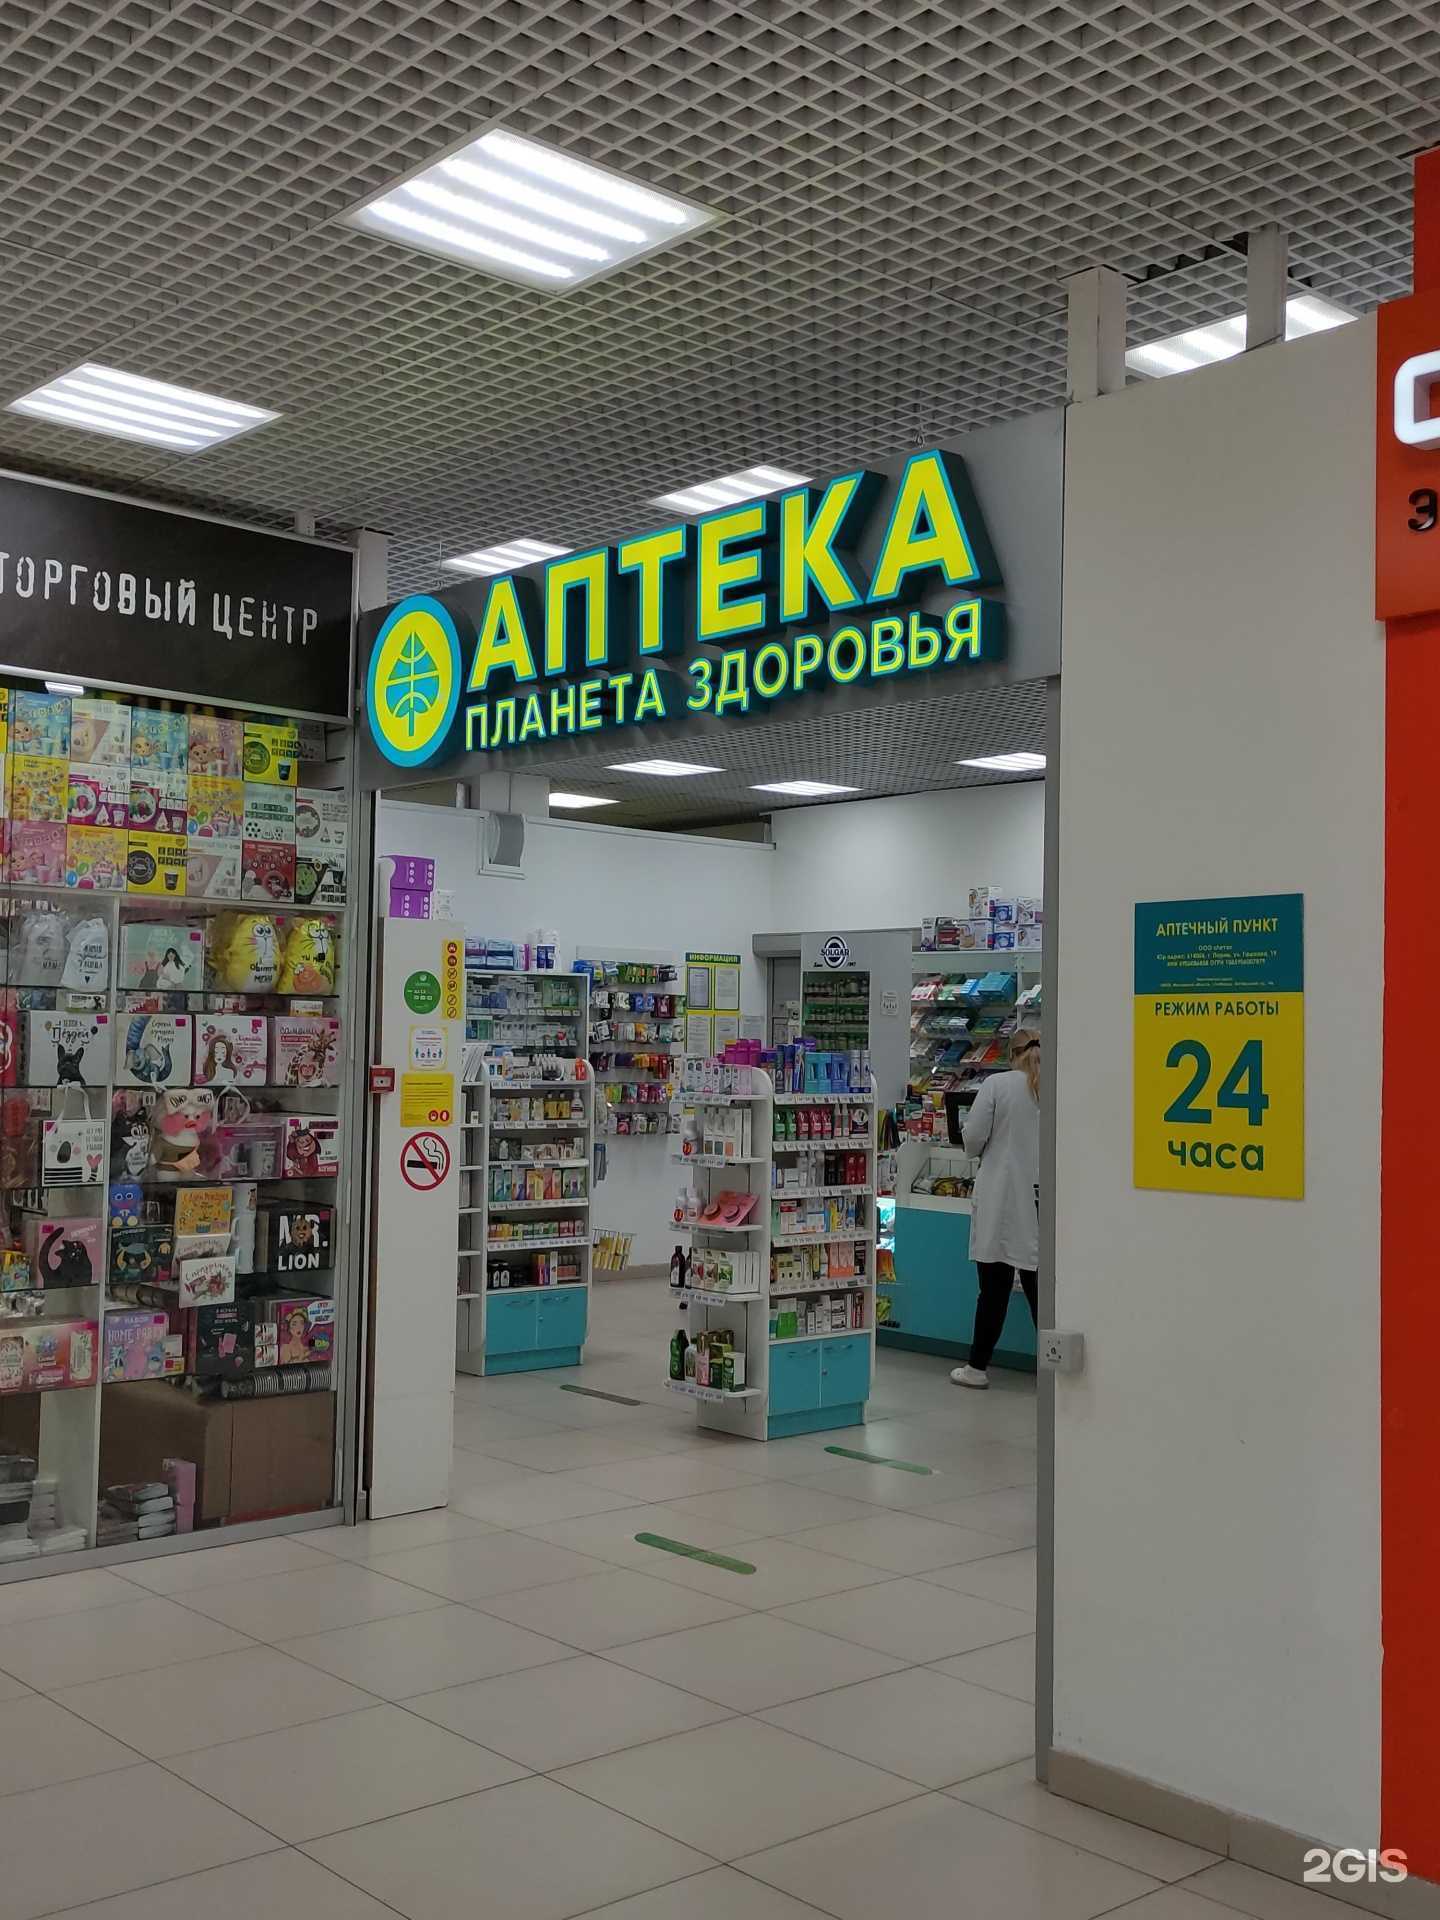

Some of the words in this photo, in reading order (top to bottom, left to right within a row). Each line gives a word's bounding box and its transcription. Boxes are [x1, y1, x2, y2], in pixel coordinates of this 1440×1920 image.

[0, 553, 196, 626] ТОРГОВЫЙ
[213, 593, 318, 645] ЦЕНТР
[465, 449, 982, 694] АПТЕКА
[464, 668, 666, 752] ПЛАНЕТА
[686, 597, 983, 717] ЗДОРОВЬЯ
[1155, 917, 1229, 937] АПТЕЧНЫЙ
[1232, 917, 1279, 933] ПУНКТ
[1155, 1001, 1210, 1017] РЕЖИМ
[1215, 1000, 1280, 1016] РАБОТЫ
[1163, 1039, 1269, 1126] 24
[1167, 1139, 1265, 1172] часа
[278, 1253, 320, 1271] LION
